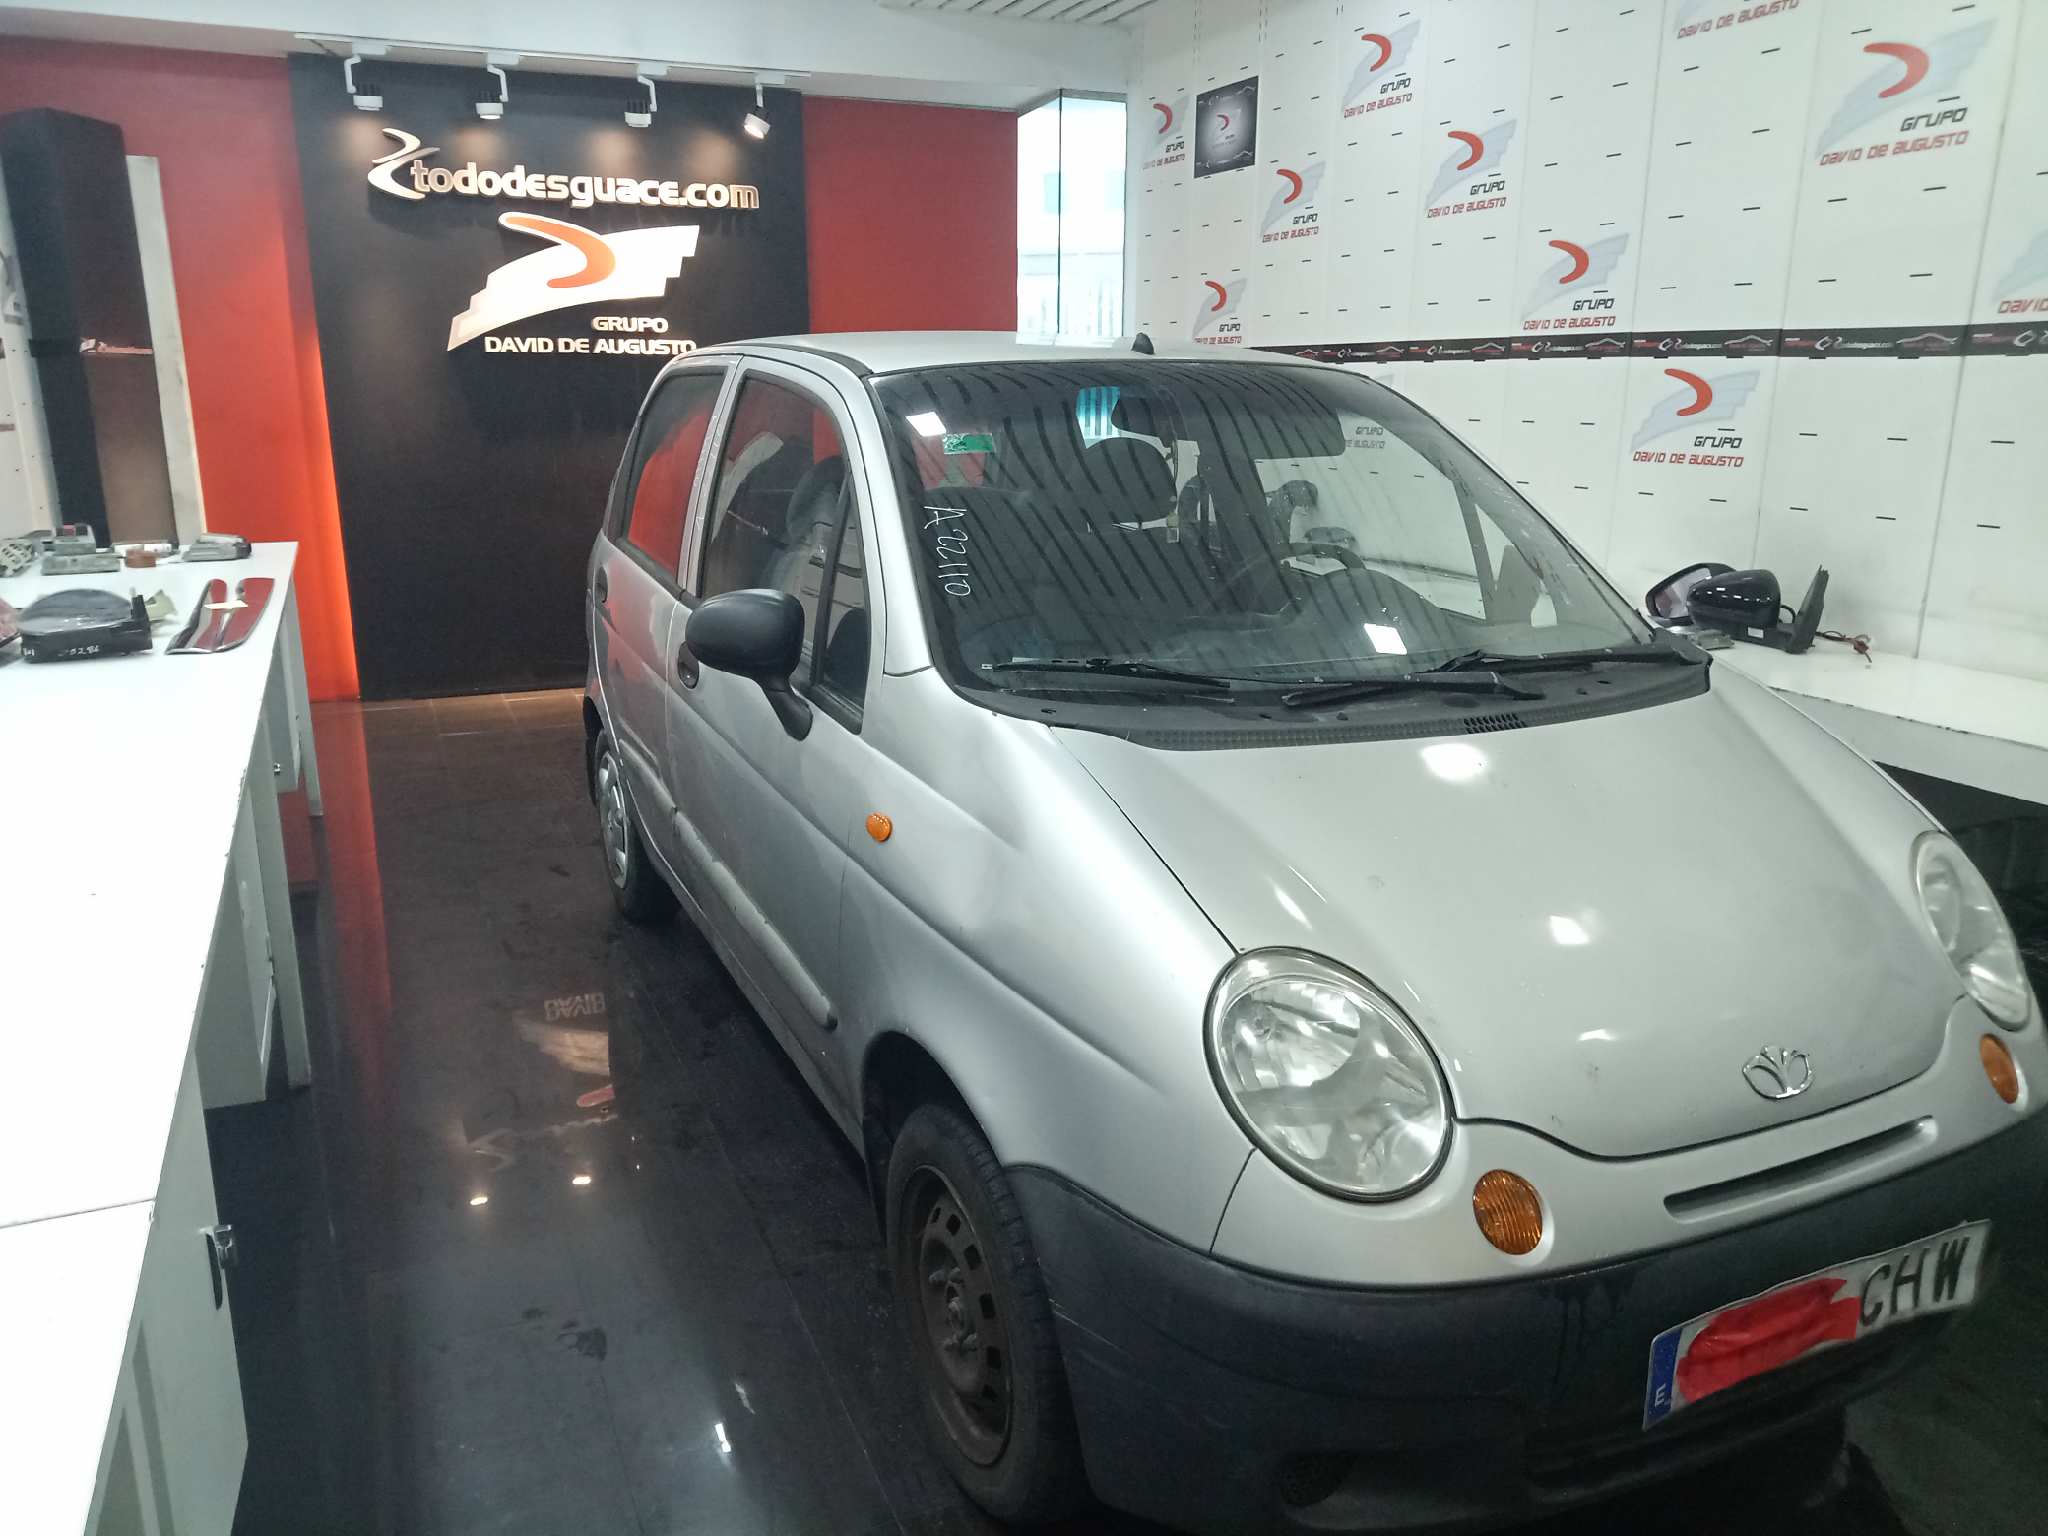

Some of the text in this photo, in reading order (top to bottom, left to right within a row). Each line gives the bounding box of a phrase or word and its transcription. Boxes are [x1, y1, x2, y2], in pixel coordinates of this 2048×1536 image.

[1380, 78, 1411, 94] GRUPO
[1900, 107, 1968, 132] GRUPO
[1820, 130, 1969, 166] DAVID DE AUGUSTO
[411, 159, 760, 209] tododesguace.com
[1470, 180, 1505, 196] GRUPO
[1573, 298, 1615, 311] GRUPO
[591, 316, 669, 333] GRUPO
[1568, 316, 1616, 328] AUGUSTO
[484, 336, 697, 355] DAVID DE AUGUSTO
[1694, 436, 1743, 449] GRUPO
[1632, 451, 1744, 468] DAVID DE AUGUSTO
[1860, 1236, 1970, 1327] CHW
